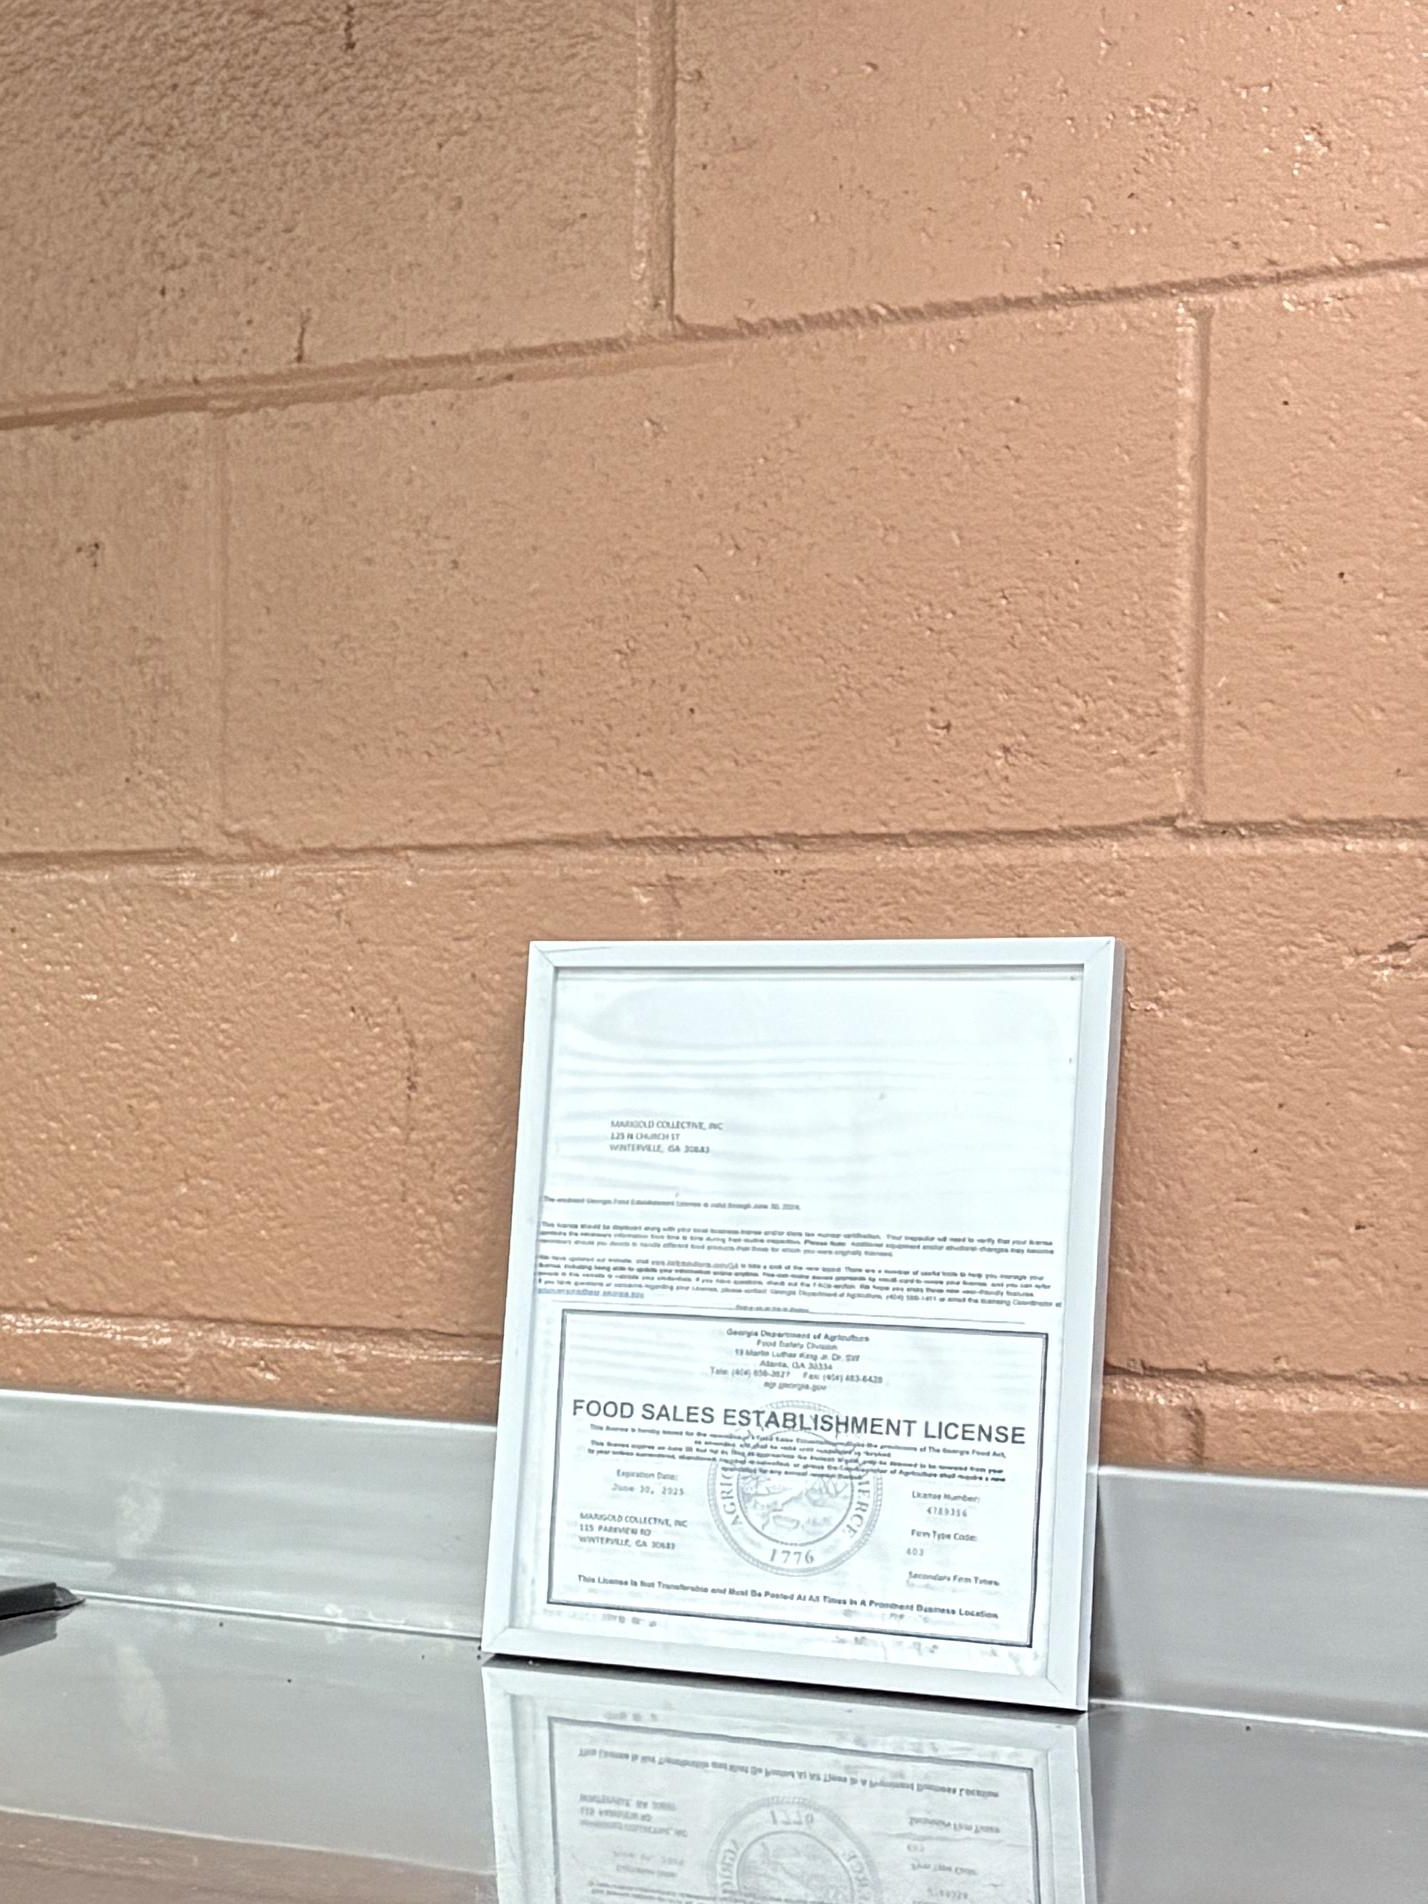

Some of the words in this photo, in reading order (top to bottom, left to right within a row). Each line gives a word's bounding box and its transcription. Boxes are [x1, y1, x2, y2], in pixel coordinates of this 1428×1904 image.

[726, 1328, 759, 1338] Georgia
[760, 1329, 811, 1340] Department
[824, 1332, 870, 1342] Agriculture
[572, 1398, 635, 1419] FOOD
[641, 1402, 715, 1425] SALES
[723, 1408, 917, 1437] ESTABLISHMENT
[924, 1420, 1026, 1444] LICENSE
[616, 1469, 655, 1480] Expiration
[769, 1548, 815, 1565] 1776
